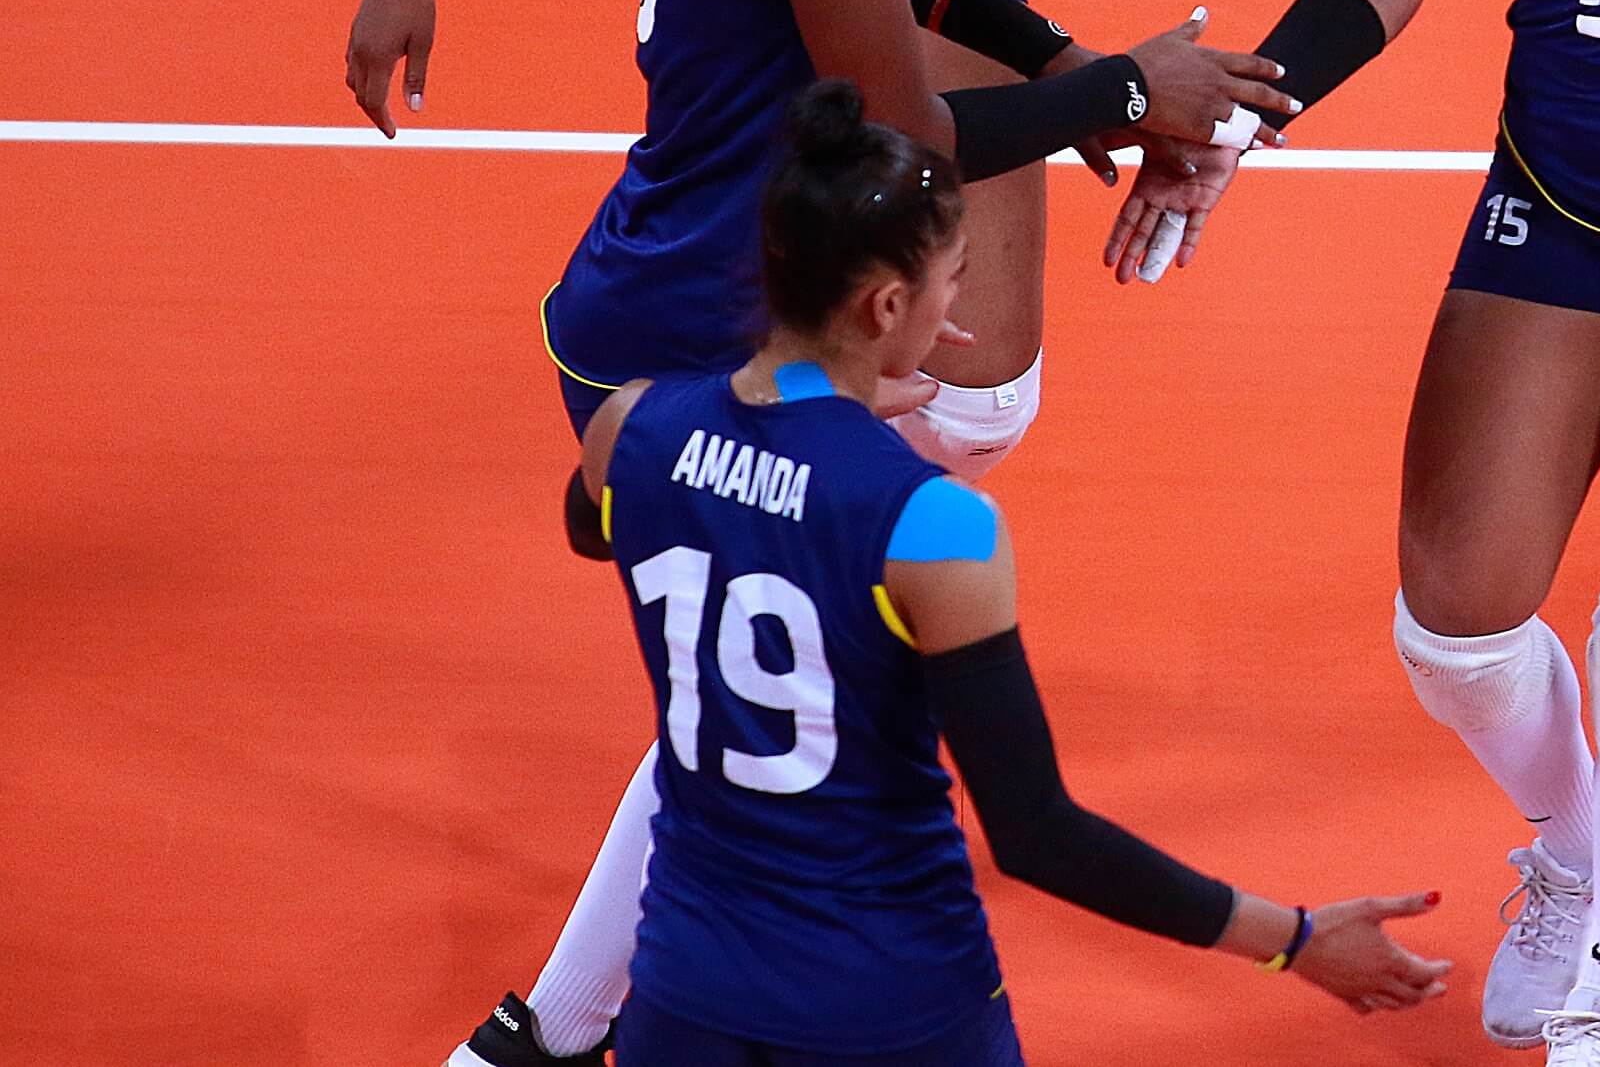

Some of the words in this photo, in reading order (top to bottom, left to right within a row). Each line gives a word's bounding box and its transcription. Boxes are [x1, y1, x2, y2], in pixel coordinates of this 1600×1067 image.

[1484, 194, 1532, 246] 15
[671, 430, 812, 522] AMANDA
[631, 546, 838, 795] 19
